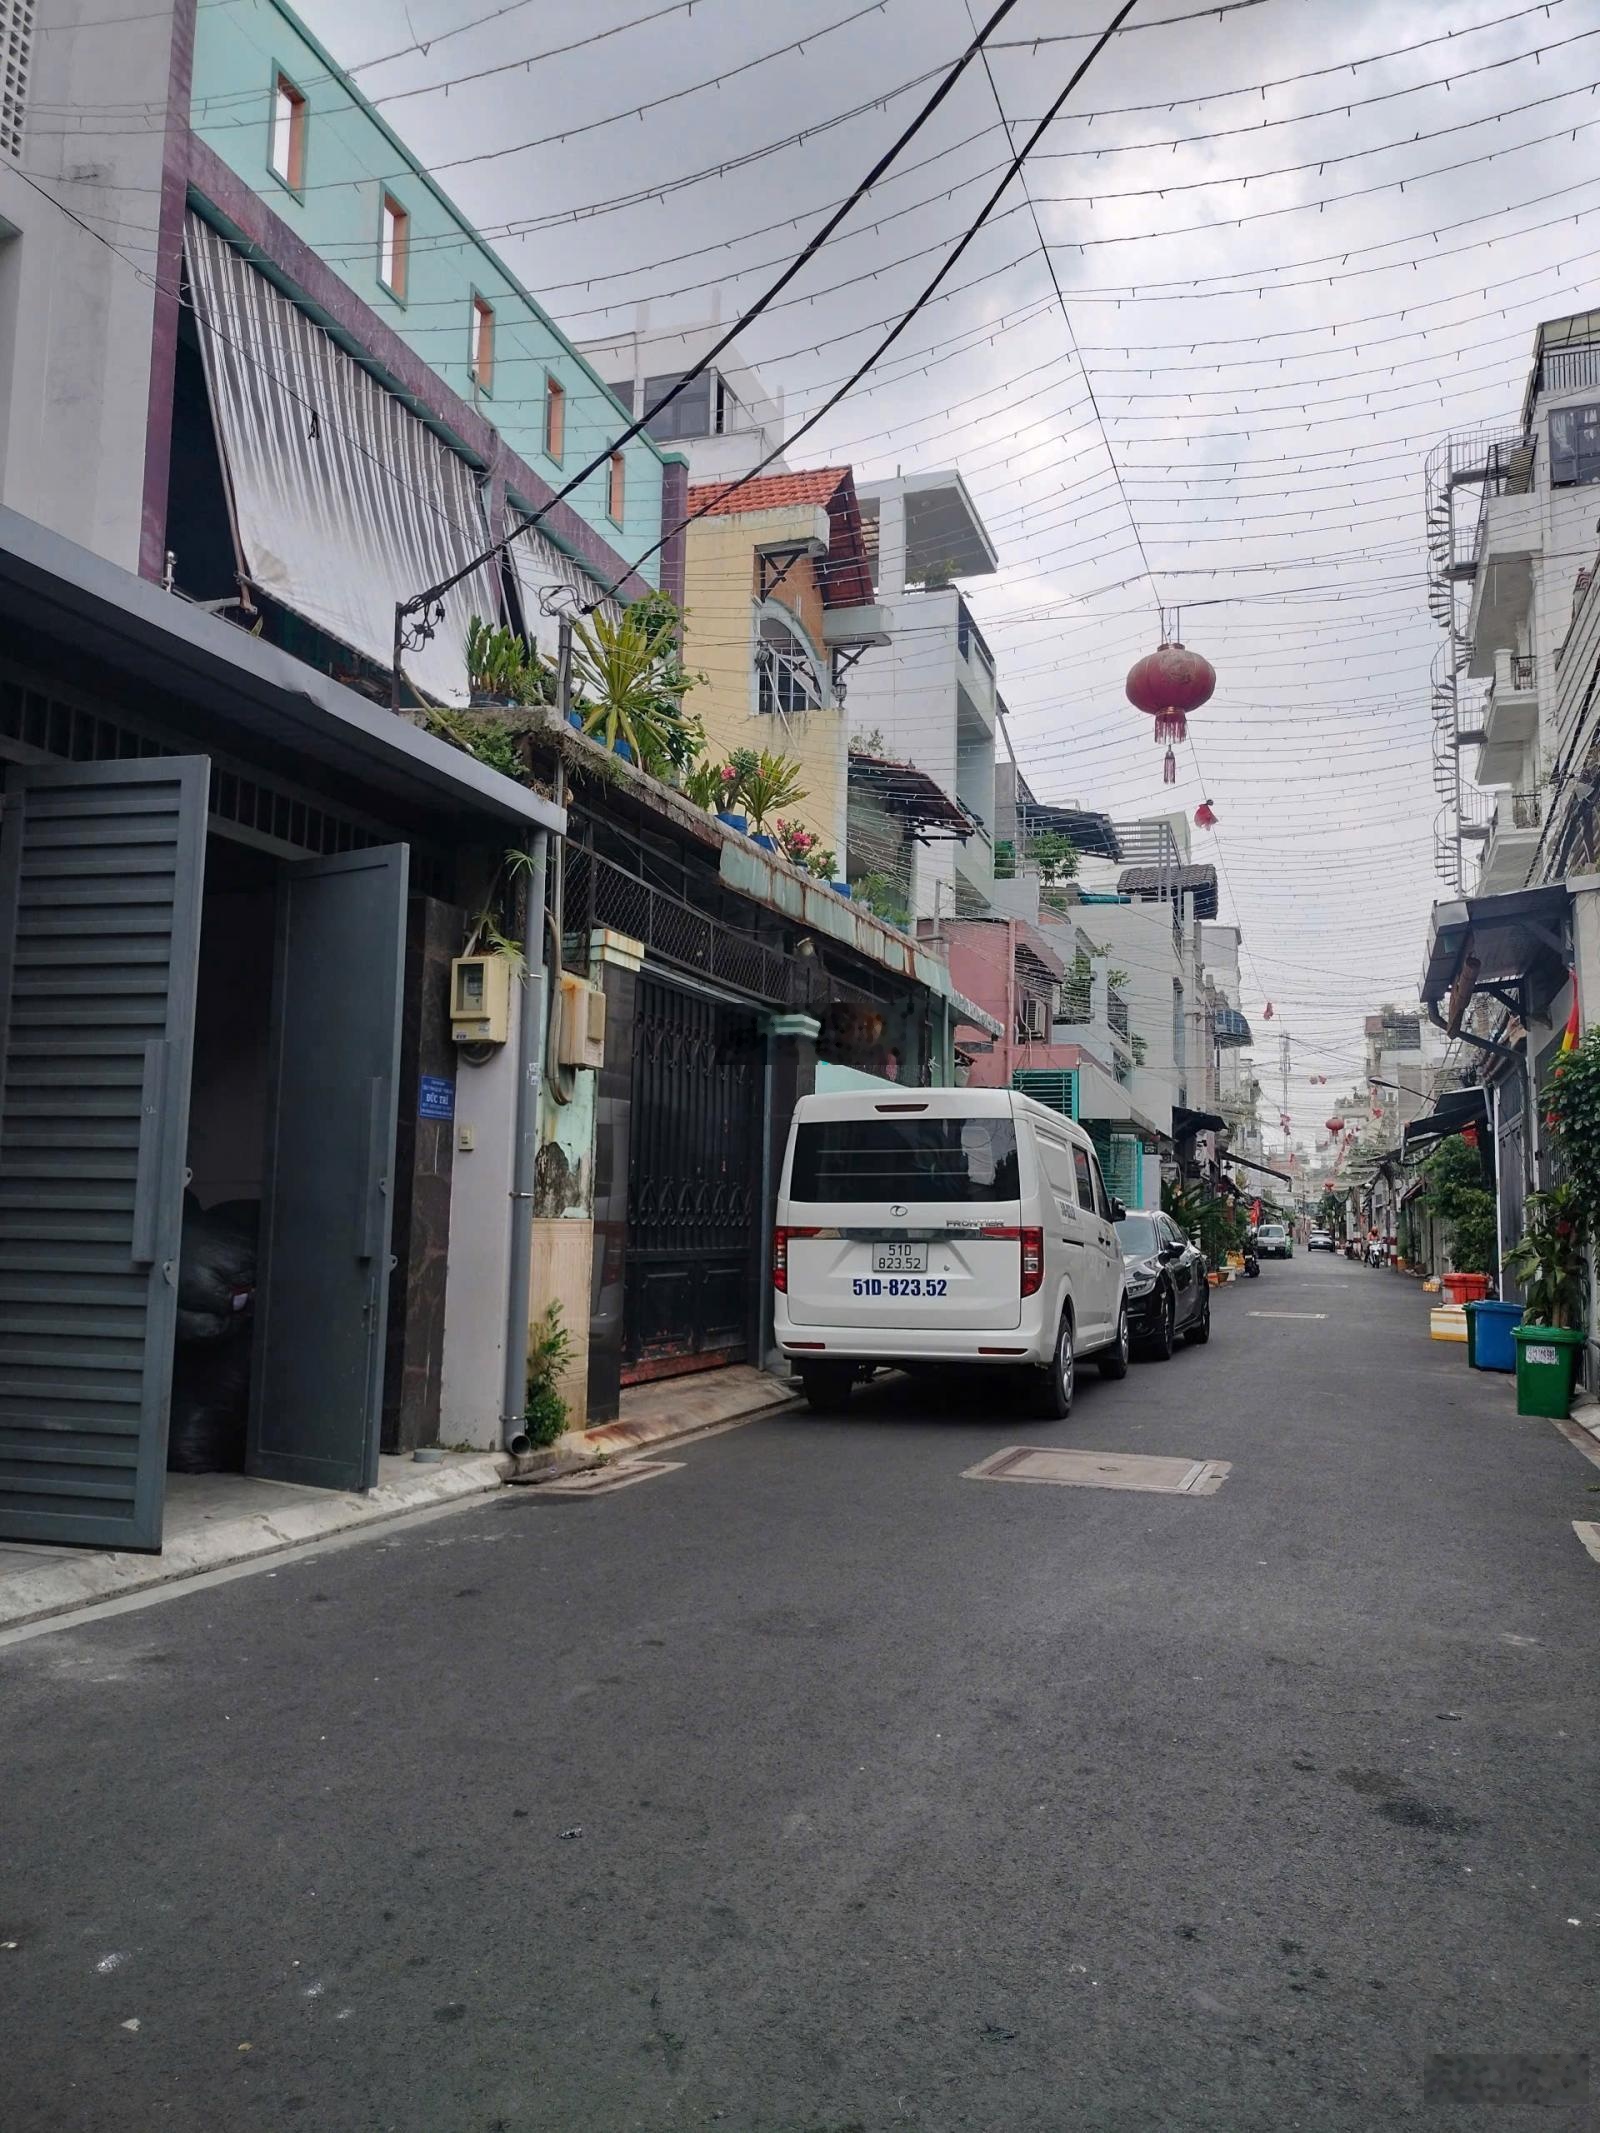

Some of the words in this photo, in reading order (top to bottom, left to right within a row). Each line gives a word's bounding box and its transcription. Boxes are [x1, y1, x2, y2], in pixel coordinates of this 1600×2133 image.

[945, 1219, 1005, 1227] FRONTIER
[888, 1244, 912, 1256] 51D
[878, 1257, 921, 1269] 823.52
[853, 1279, 947, 1296] 51D-823.52
